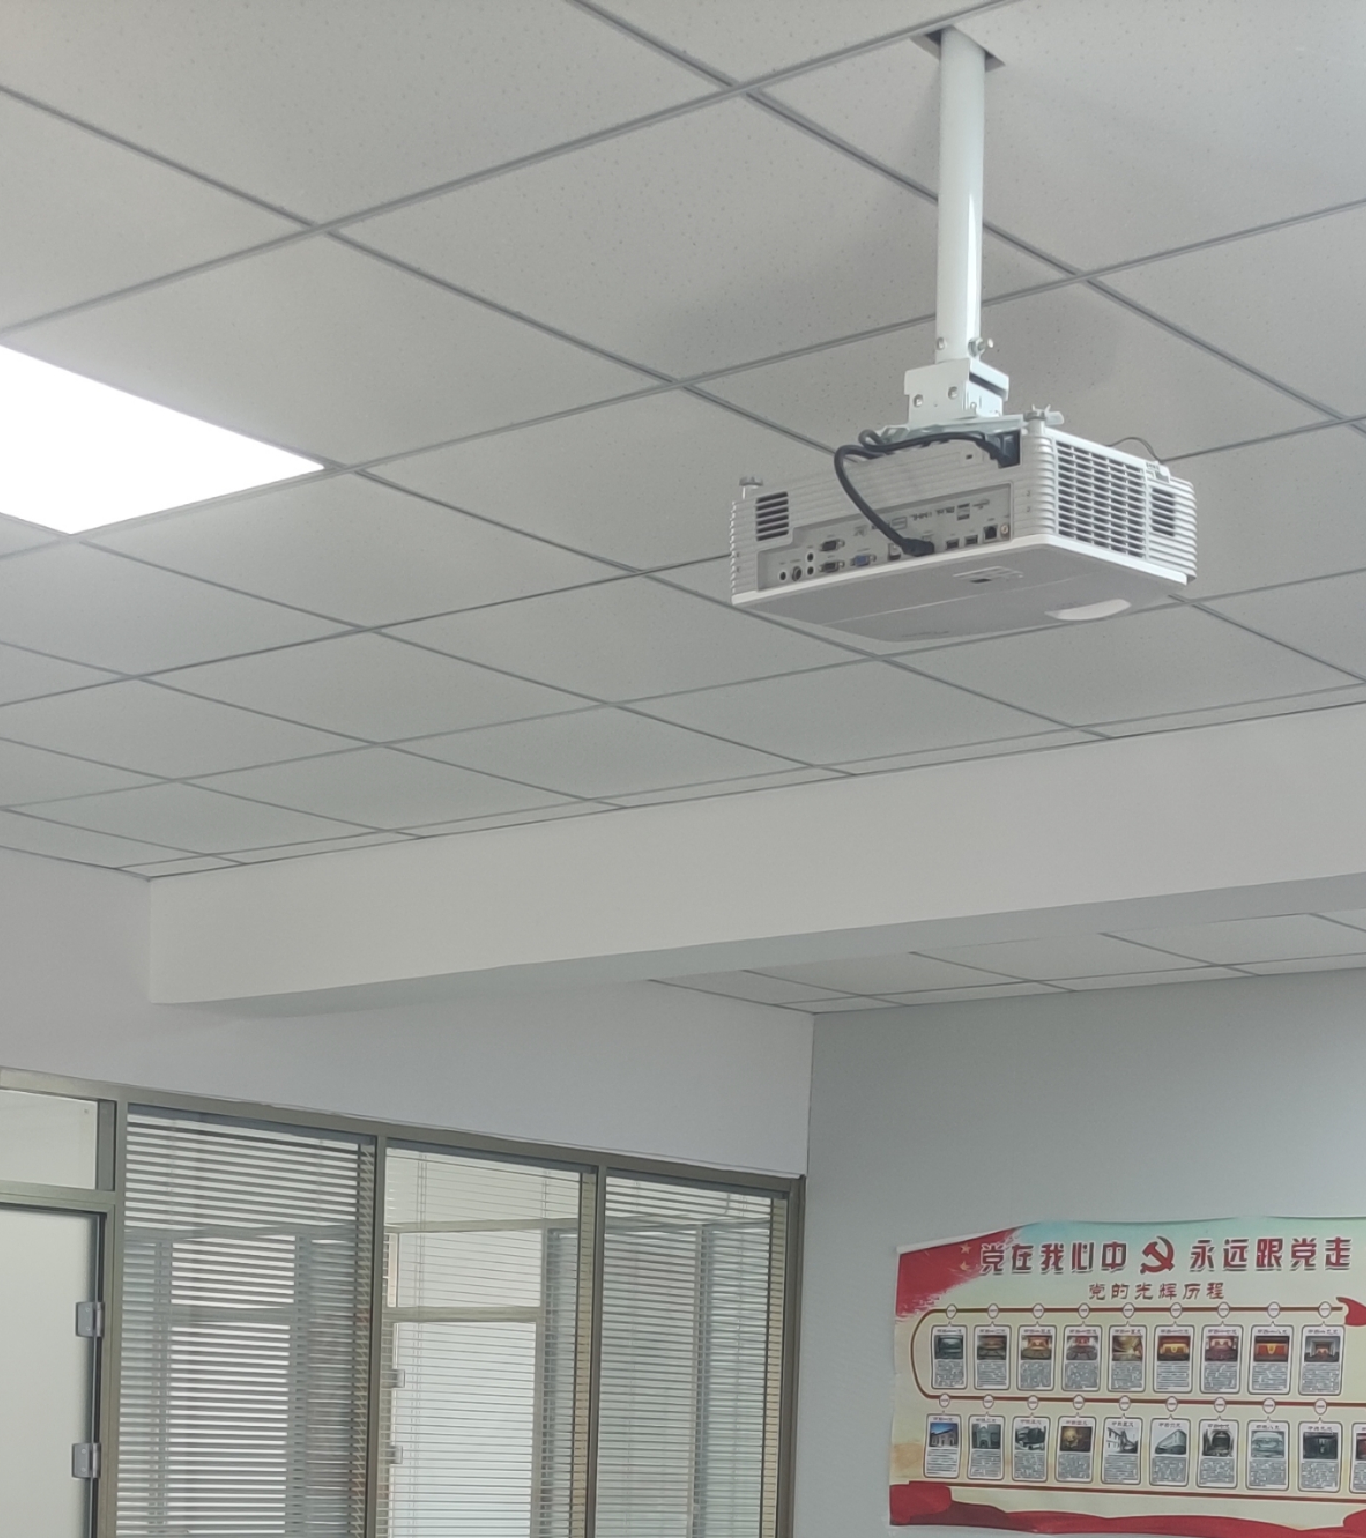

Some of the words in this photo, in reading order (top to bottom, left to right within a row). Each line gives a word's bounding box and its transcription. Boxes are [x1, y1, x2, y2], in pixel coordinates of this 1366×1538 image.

[980, 1240, 1128, 1274] 党在我心中
[1190, 1237, 1351, 1271] 永远跟党走
[1088, 1281, 1226, 1302] 党的光辉历程
